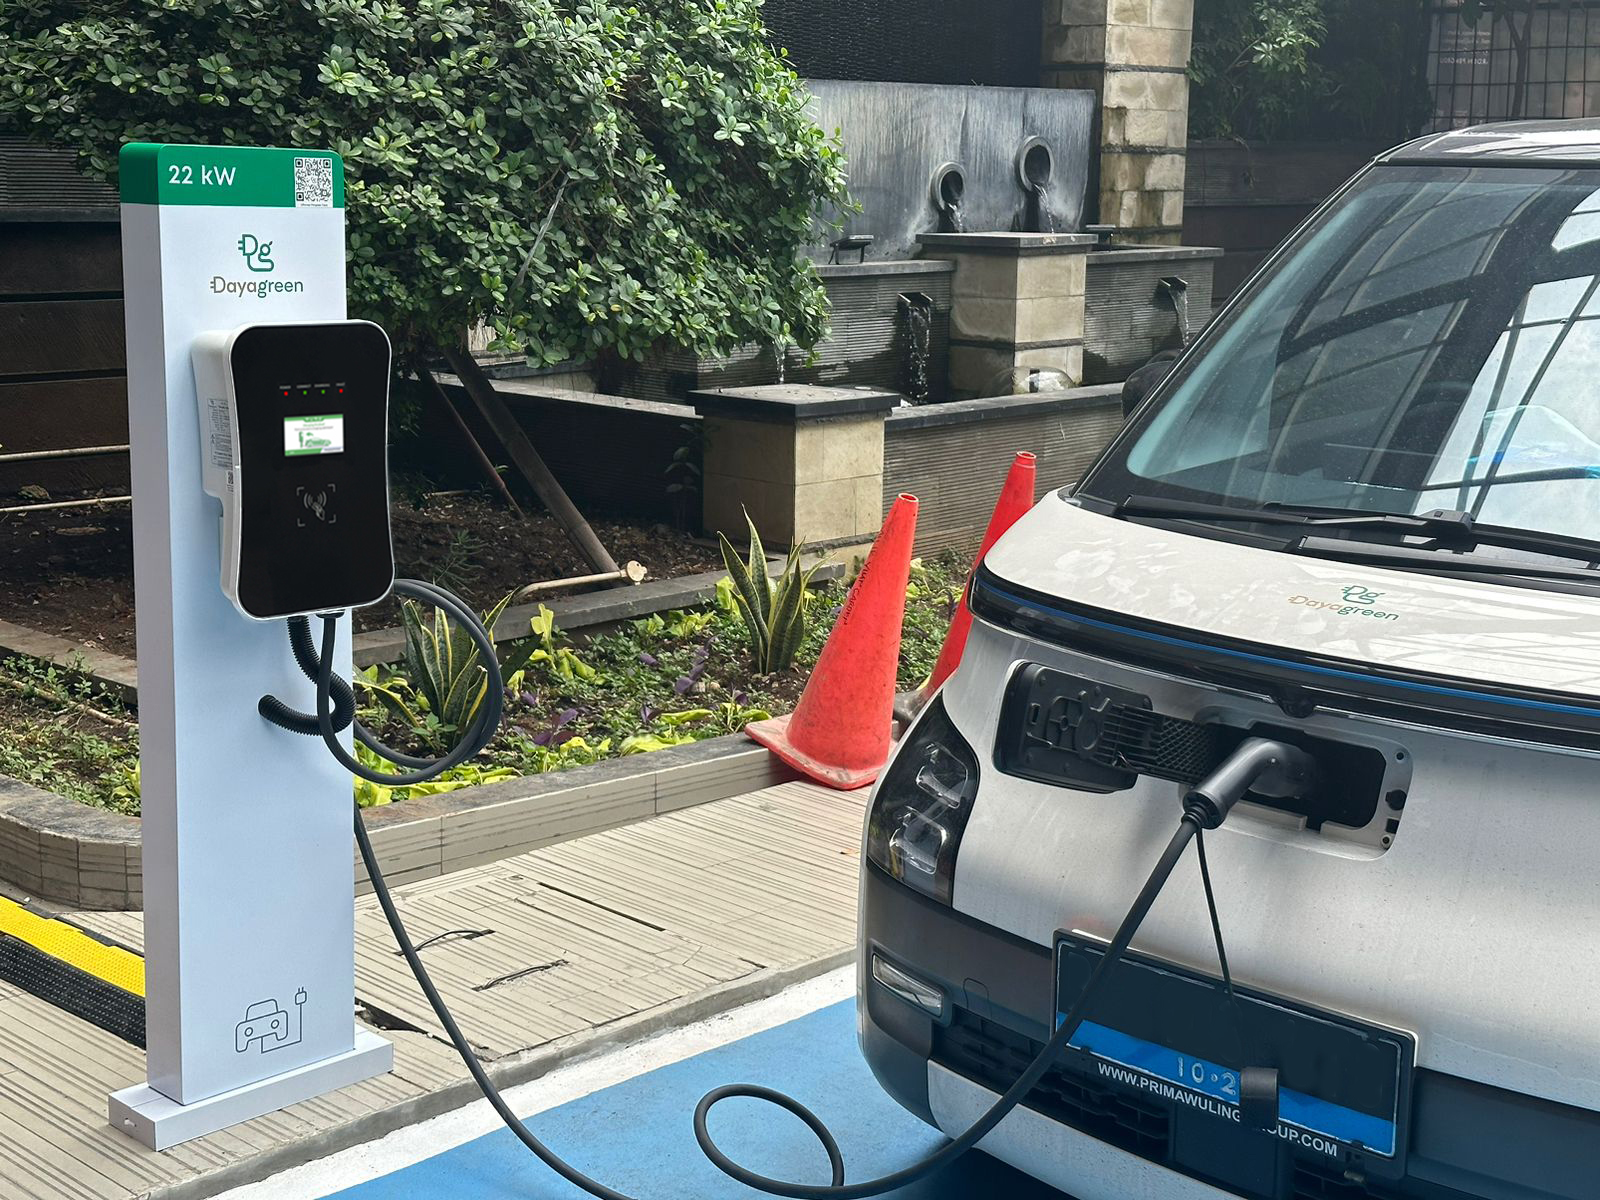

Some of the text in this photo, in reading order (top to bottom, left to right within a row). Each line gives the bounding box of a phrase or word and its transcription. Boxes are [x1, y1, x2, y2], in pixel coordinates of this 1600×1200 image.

[168, 165, 236, 186] 22 kW
[210, 276, 304, 298] Dayagreen
[1288, 595, 1399, 621] Dayagreen
[1097, 1062, 1338, 1157] WWW.PRIMAWULINGUP.COM
